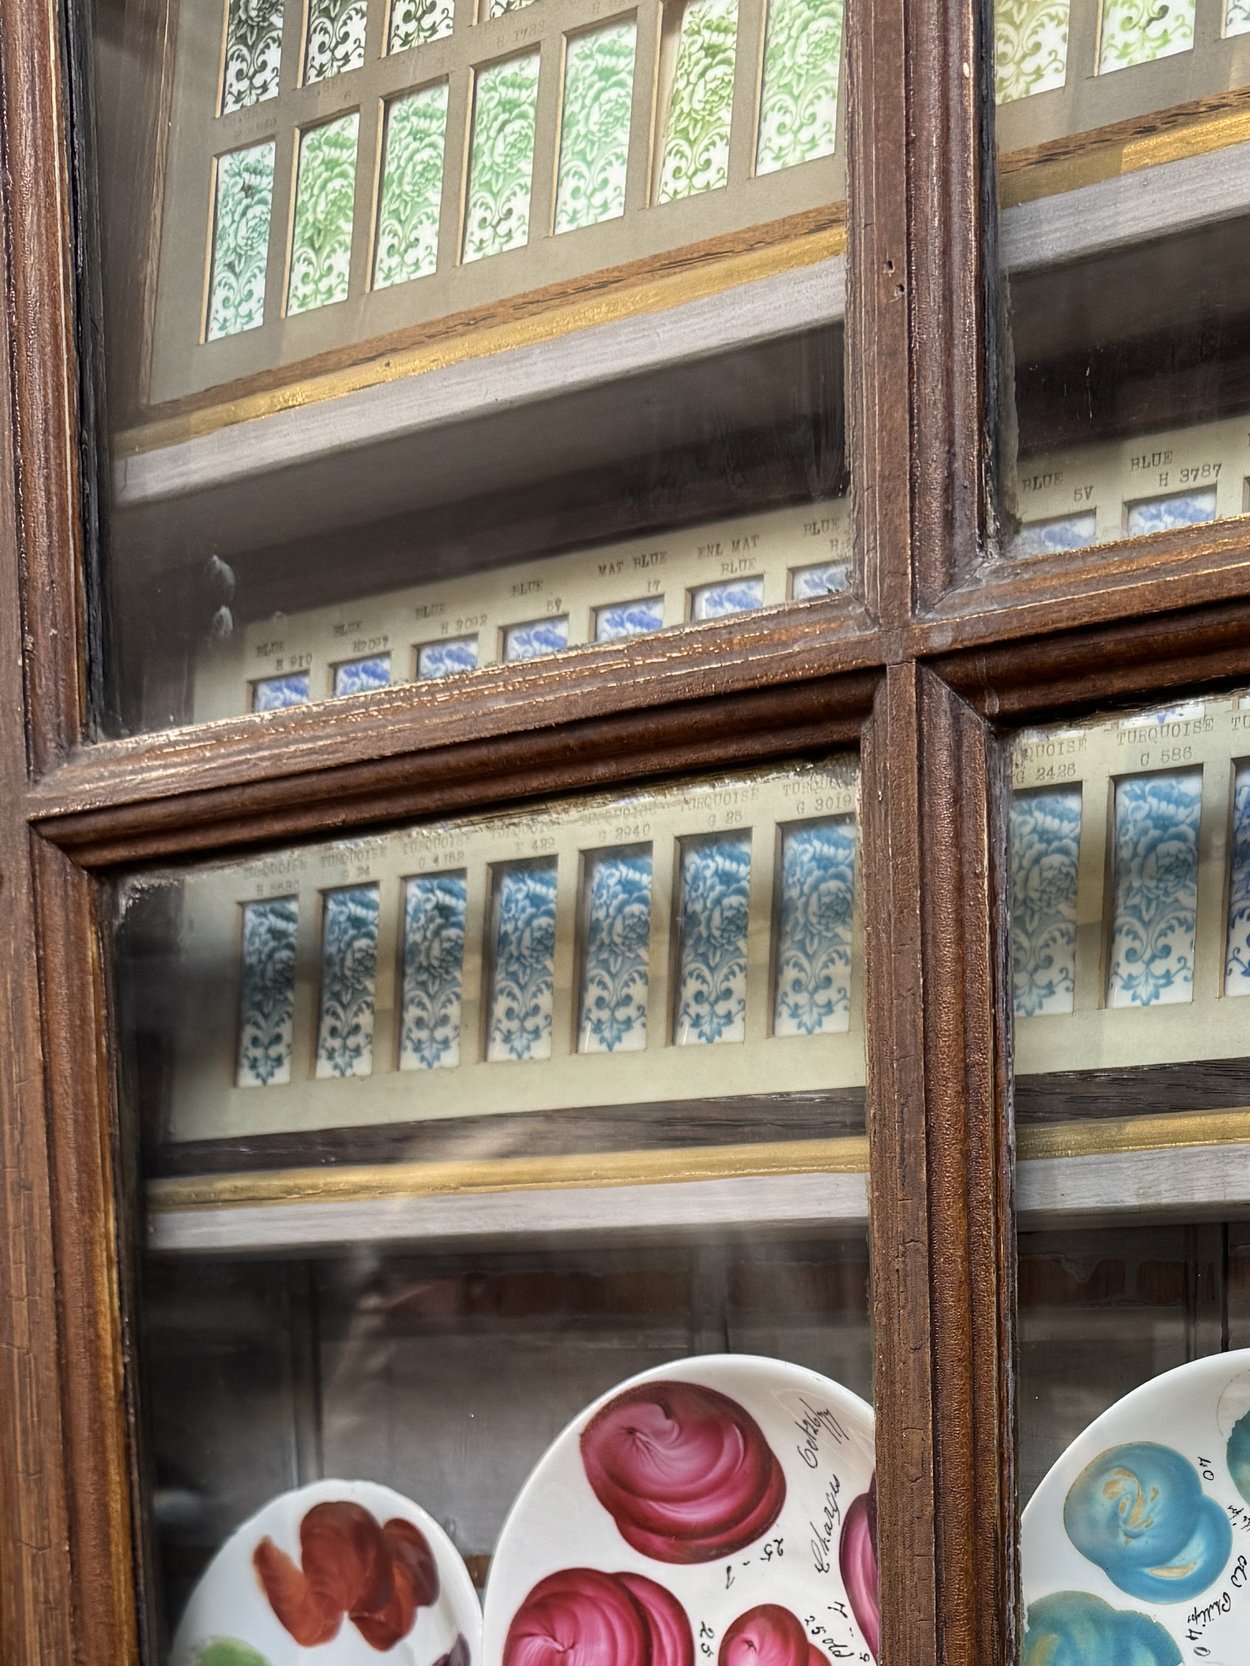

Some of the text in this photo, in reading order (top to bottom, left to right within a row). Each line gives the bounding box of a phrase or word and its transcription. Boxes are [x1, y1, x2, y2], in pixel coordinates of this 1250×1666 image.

[1130, 450, 1174, 472] BLUE
[1022, 472, 1064, 492] BLUE
[1158, 462, 1223, 487] H 3787
[731, 534, 760, 553] MAT
[632, 551, 668, 570] BLUE
[720, 556, 757, 576] BLUE
[1117, 717, 1215, 746] TURQUOISE
[1161, 746, 1193, 763] 586
[1037, 763, 1077, 782] 2426
